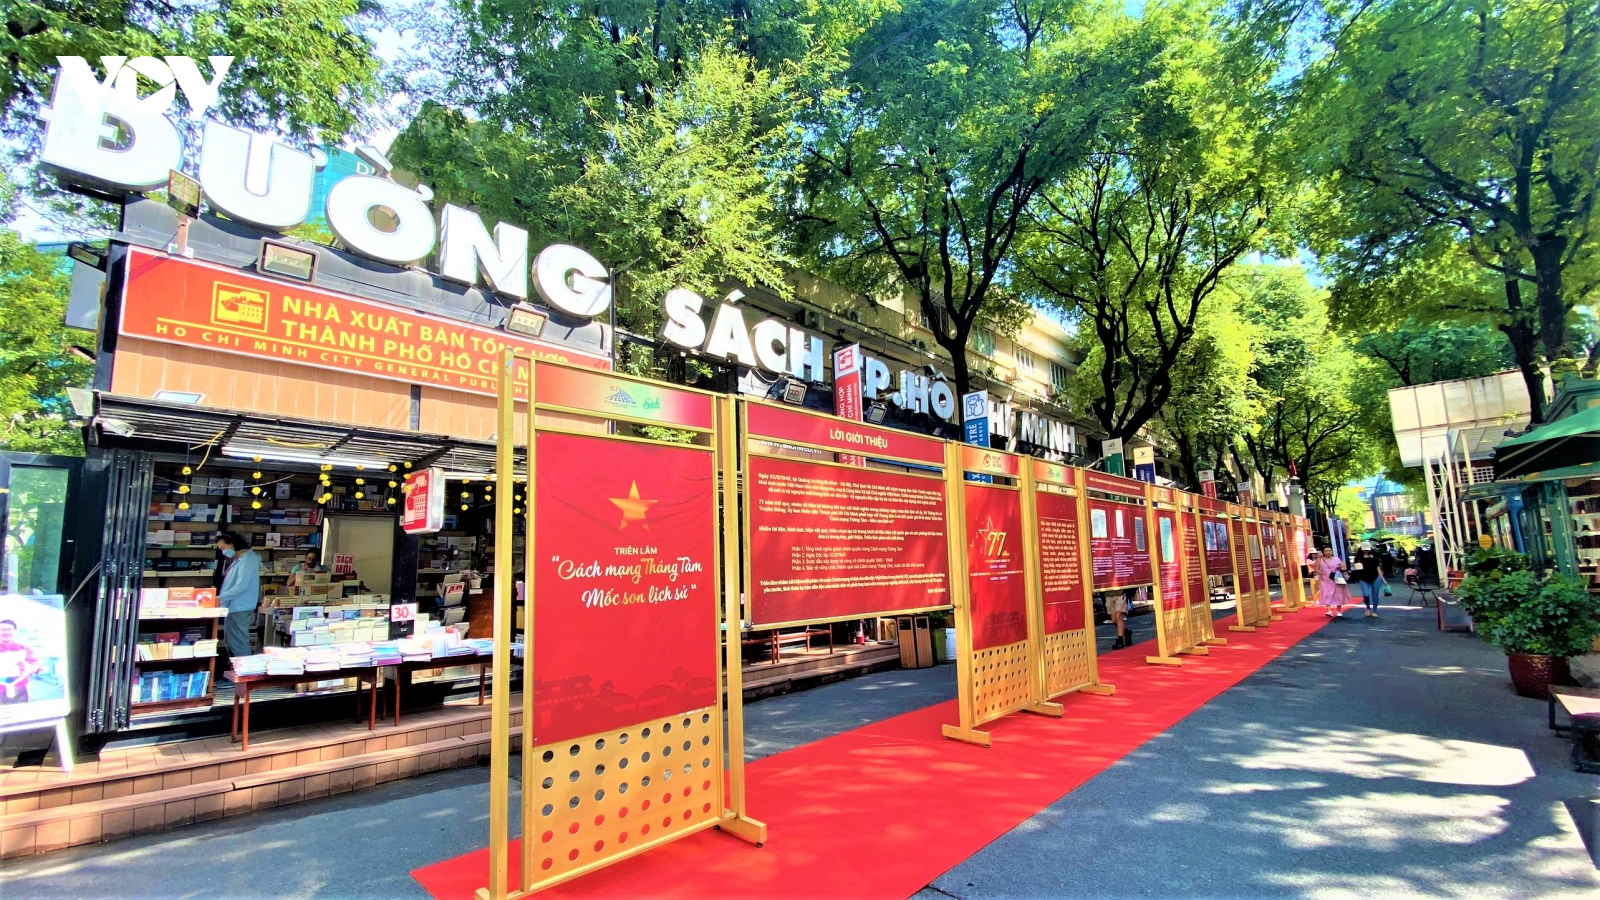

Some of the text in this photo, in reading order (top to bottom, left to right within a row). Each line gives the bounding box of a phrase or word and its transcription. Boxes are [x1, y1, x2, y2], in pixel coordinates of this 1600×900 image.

[38, 66, 612, 318] ĐƯỜNG
[660, 287, 824, 383] SÁCH
[283, 295, 341, 324] NHÀ
[350, 310, 413, 338] XUẤT
[420, 325, 464, 348] BẢN
[156, 323, 187, 337] HO
[202, 331, 240, 347] CHI
[254, 341, 307, 358] MINH
[320, 352, 363, 367] CITY
[374, 362, 450, 382] GENERAL
[281, 319, 375, 353] THÀNH
[384, 340, 433, 363] PHỐ
[440, 350, 471, 370] HỒ
[478, 359, 499, 375] CH
[830, 428, 888, 448] LỜI GIỚI THIỆU
[614, 545, 658, 555] TRIỂN LÃM
[988, 532, 1006, 556] 77
[336, 554, 353, 564] SÁCH
[605, 564, 642, 584] mạng
[640, 557, 678, 582] Tháng
[677, 556, 702, 573] Tám
[581, 588, 620, 608] Mốc
[622, 591, 645, 605] son
[648, 585, 672, 605] lịch
